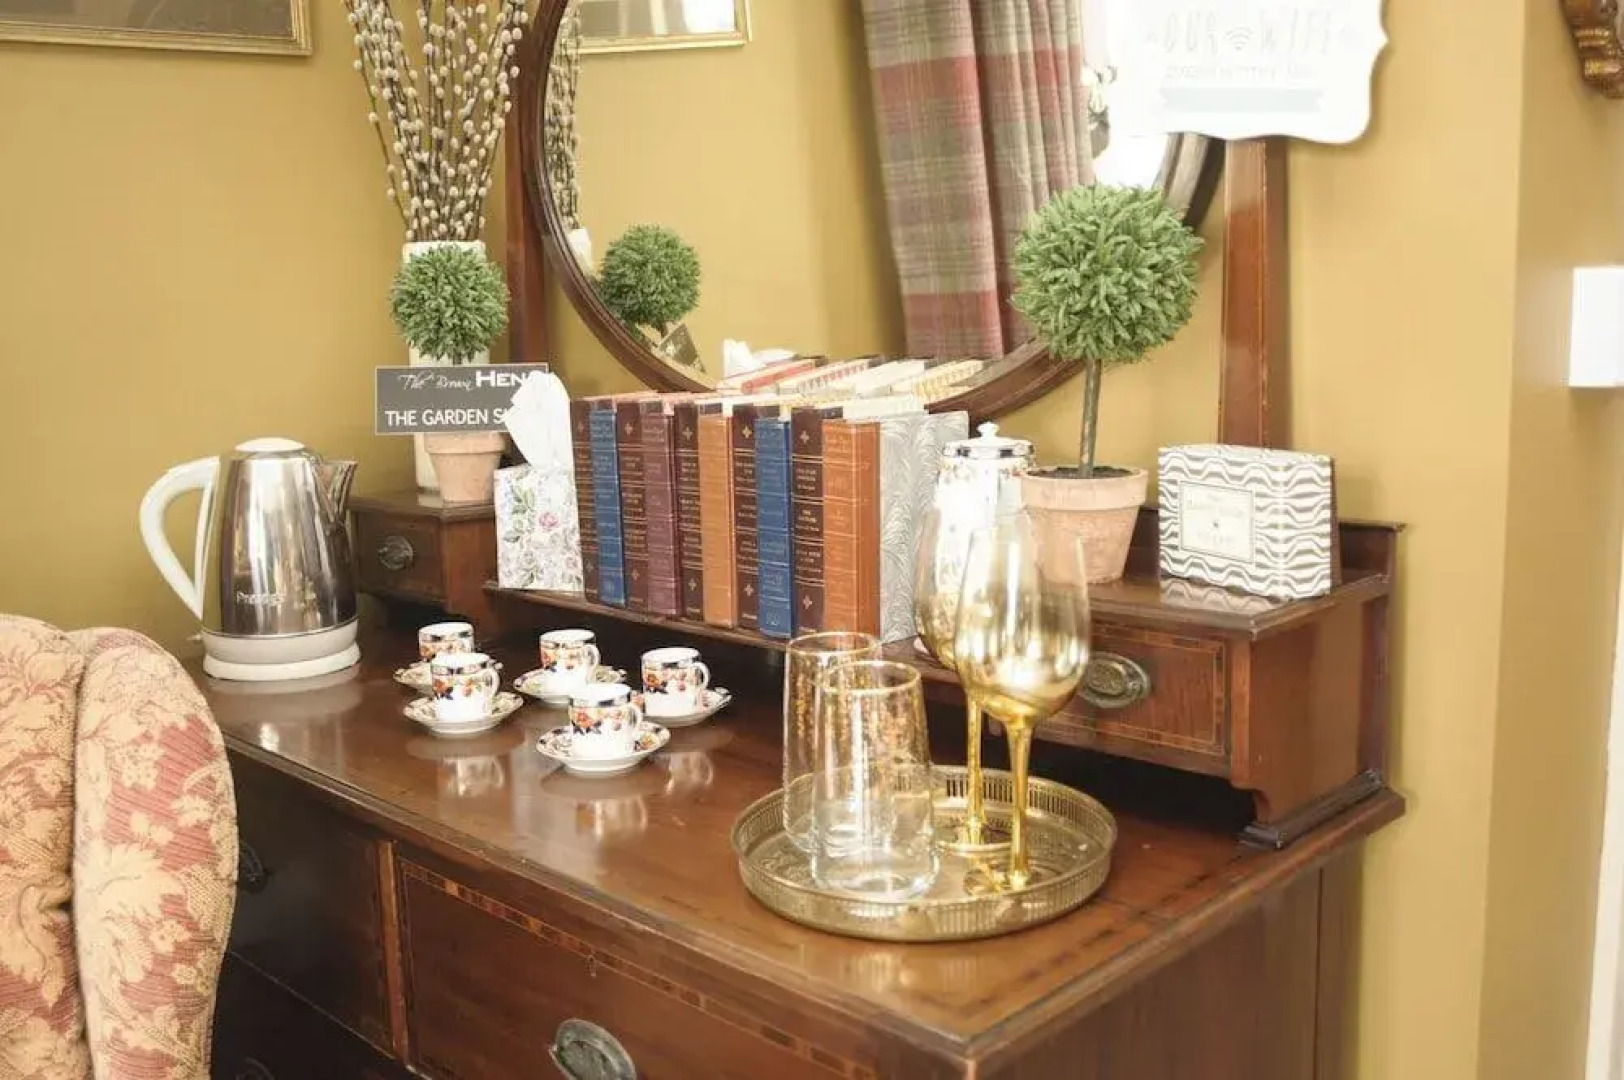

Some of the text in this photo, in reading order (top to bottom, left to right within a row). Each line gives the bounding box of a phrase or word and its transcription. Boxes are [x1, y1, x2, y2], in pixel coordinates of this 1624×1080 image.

[397, 369, 434, 391] The
[385, 410, 417, 427] THE
[421, 408, 488, 426] GARDEN
